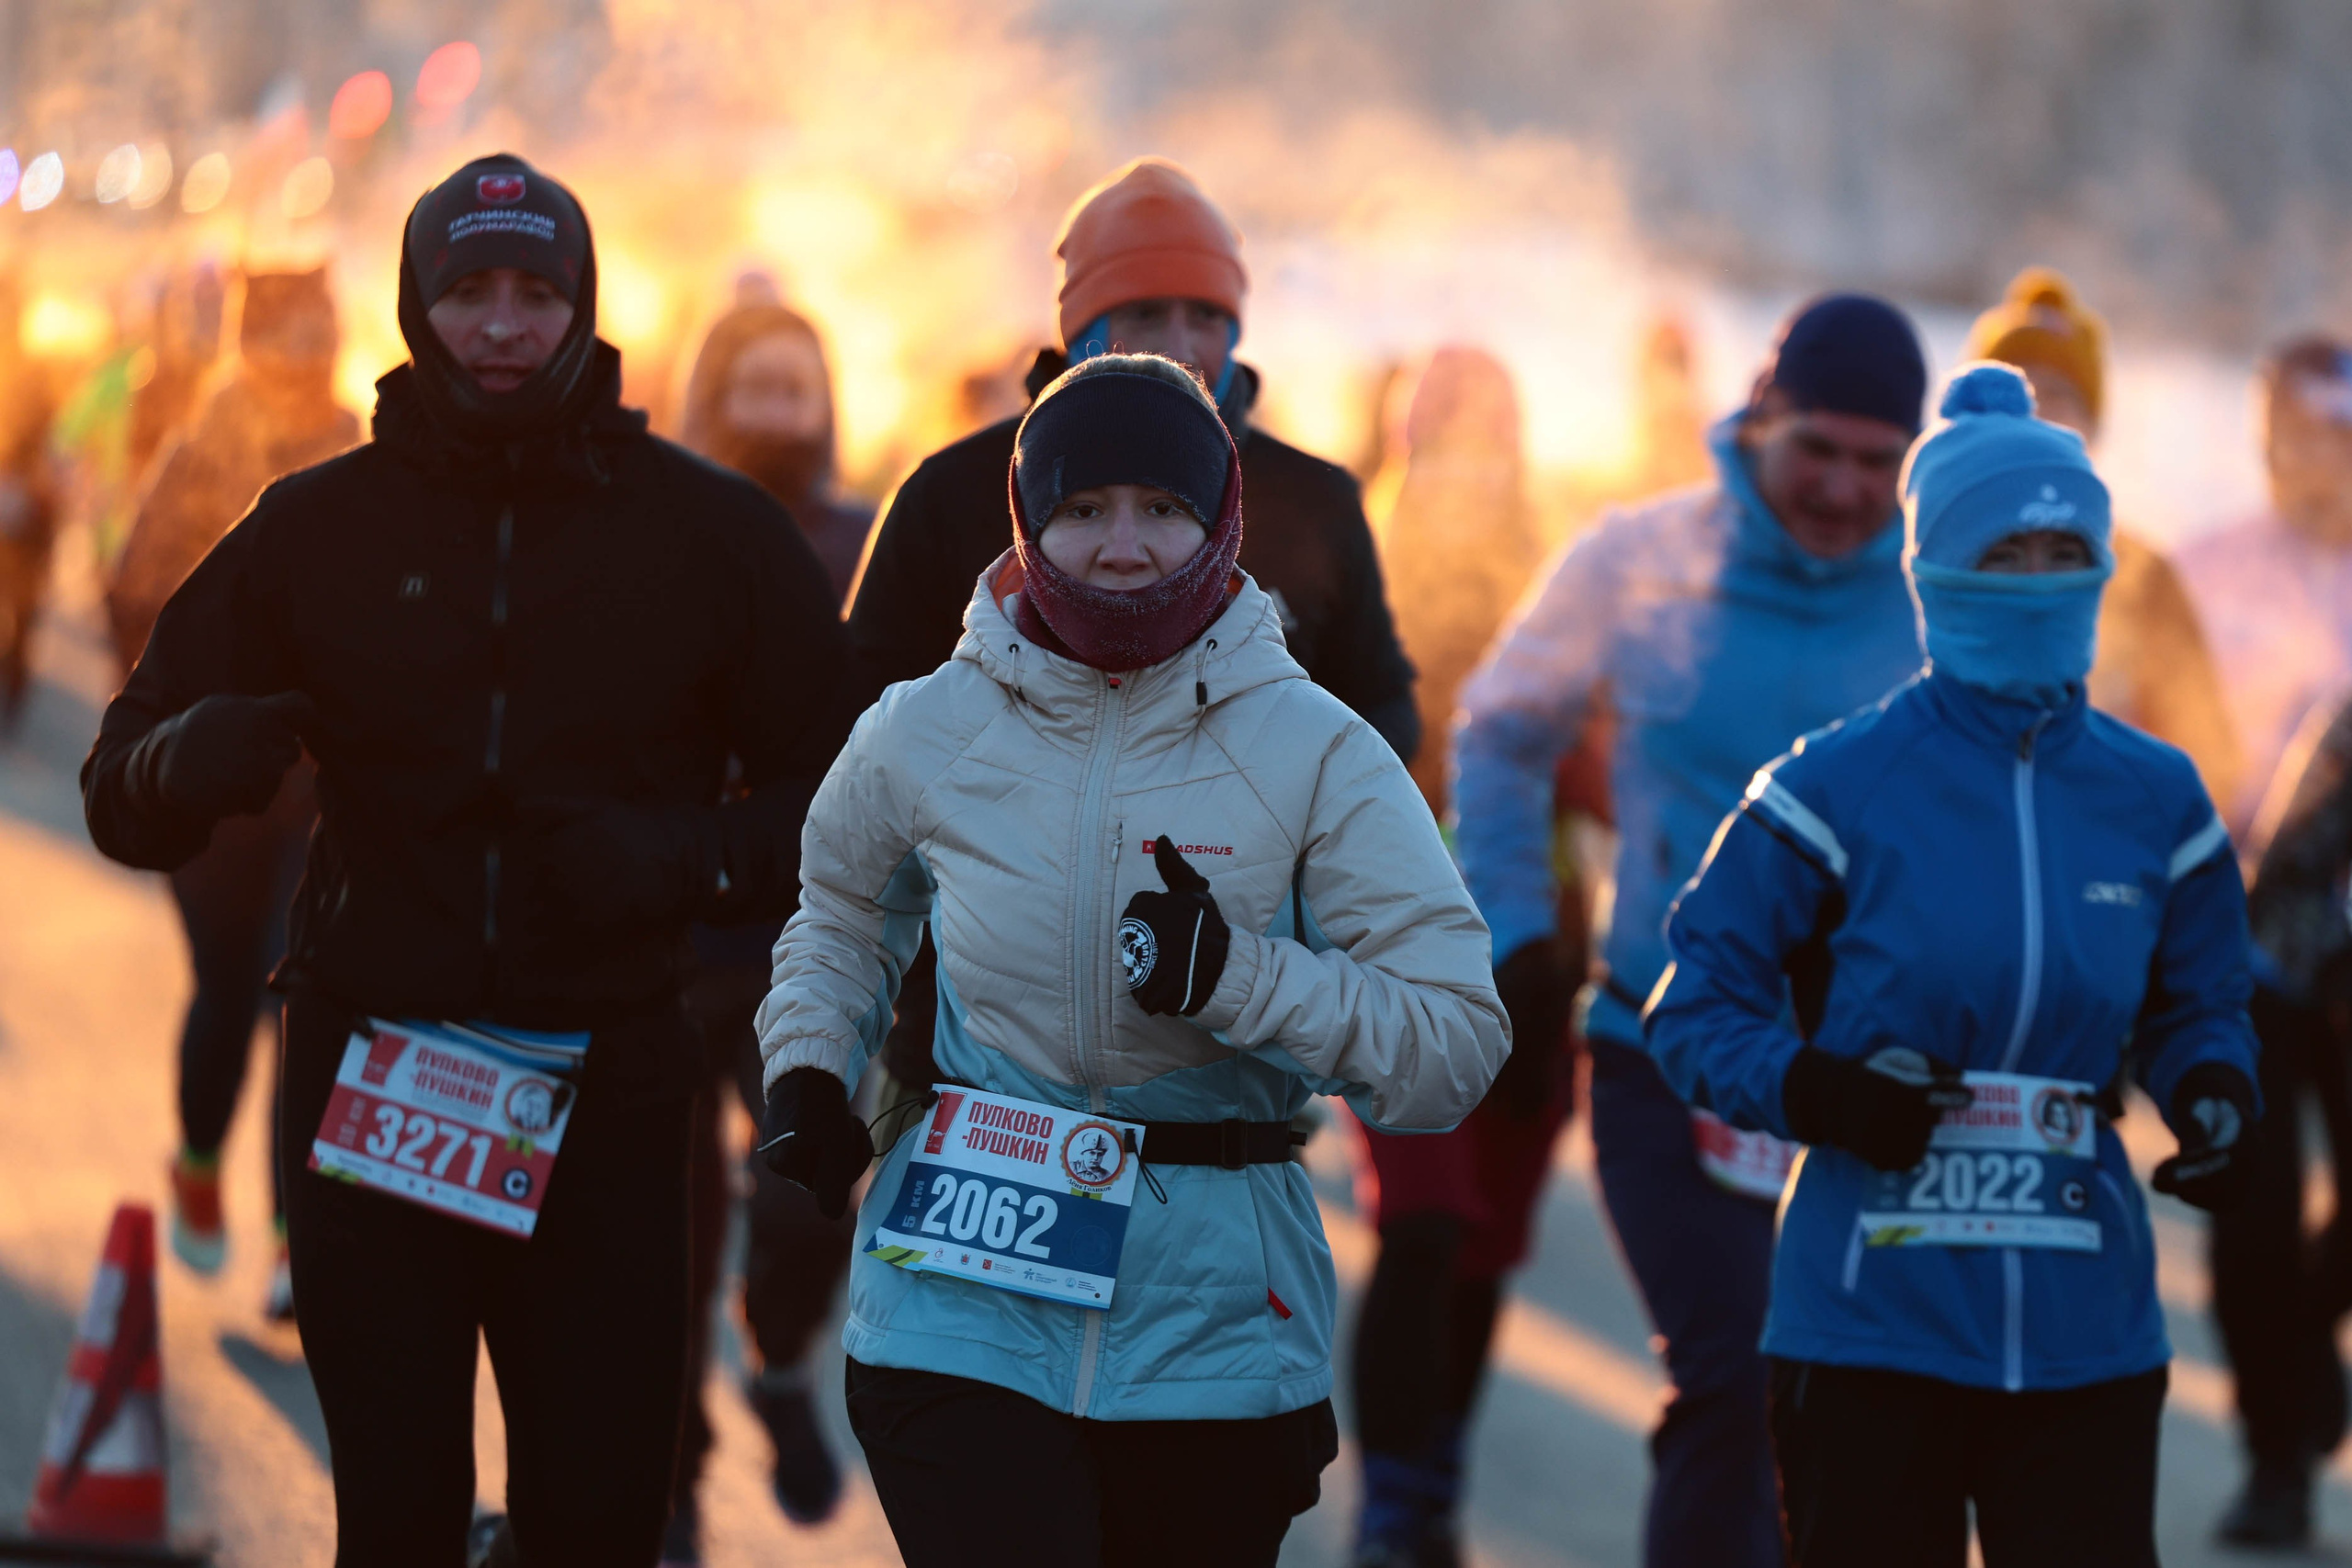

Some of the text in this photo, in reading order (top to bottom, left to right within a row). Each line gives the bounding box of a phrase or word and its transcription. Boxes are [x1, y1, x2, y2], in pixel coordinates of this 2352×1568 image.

[1176, 844, 1233, 855] ADSHUS
[1141, 943, 1149, 967] CLUB
[416, 1046, 500, 1088] ПУЛКОВО
[1973, 1084, 2020, 1104] КОВО
[968, 1101, 1055, 1139] ПУЛКОВО
[365, 1105, 492, 1189] 3271
[962, 1127, 1050, 1165] -ПУШКИН
[1908, 1152, 2044, 1212] 2022
[901, 1214, 916, 1228] 5
[921, 1173, 1058, 1259] 2062
